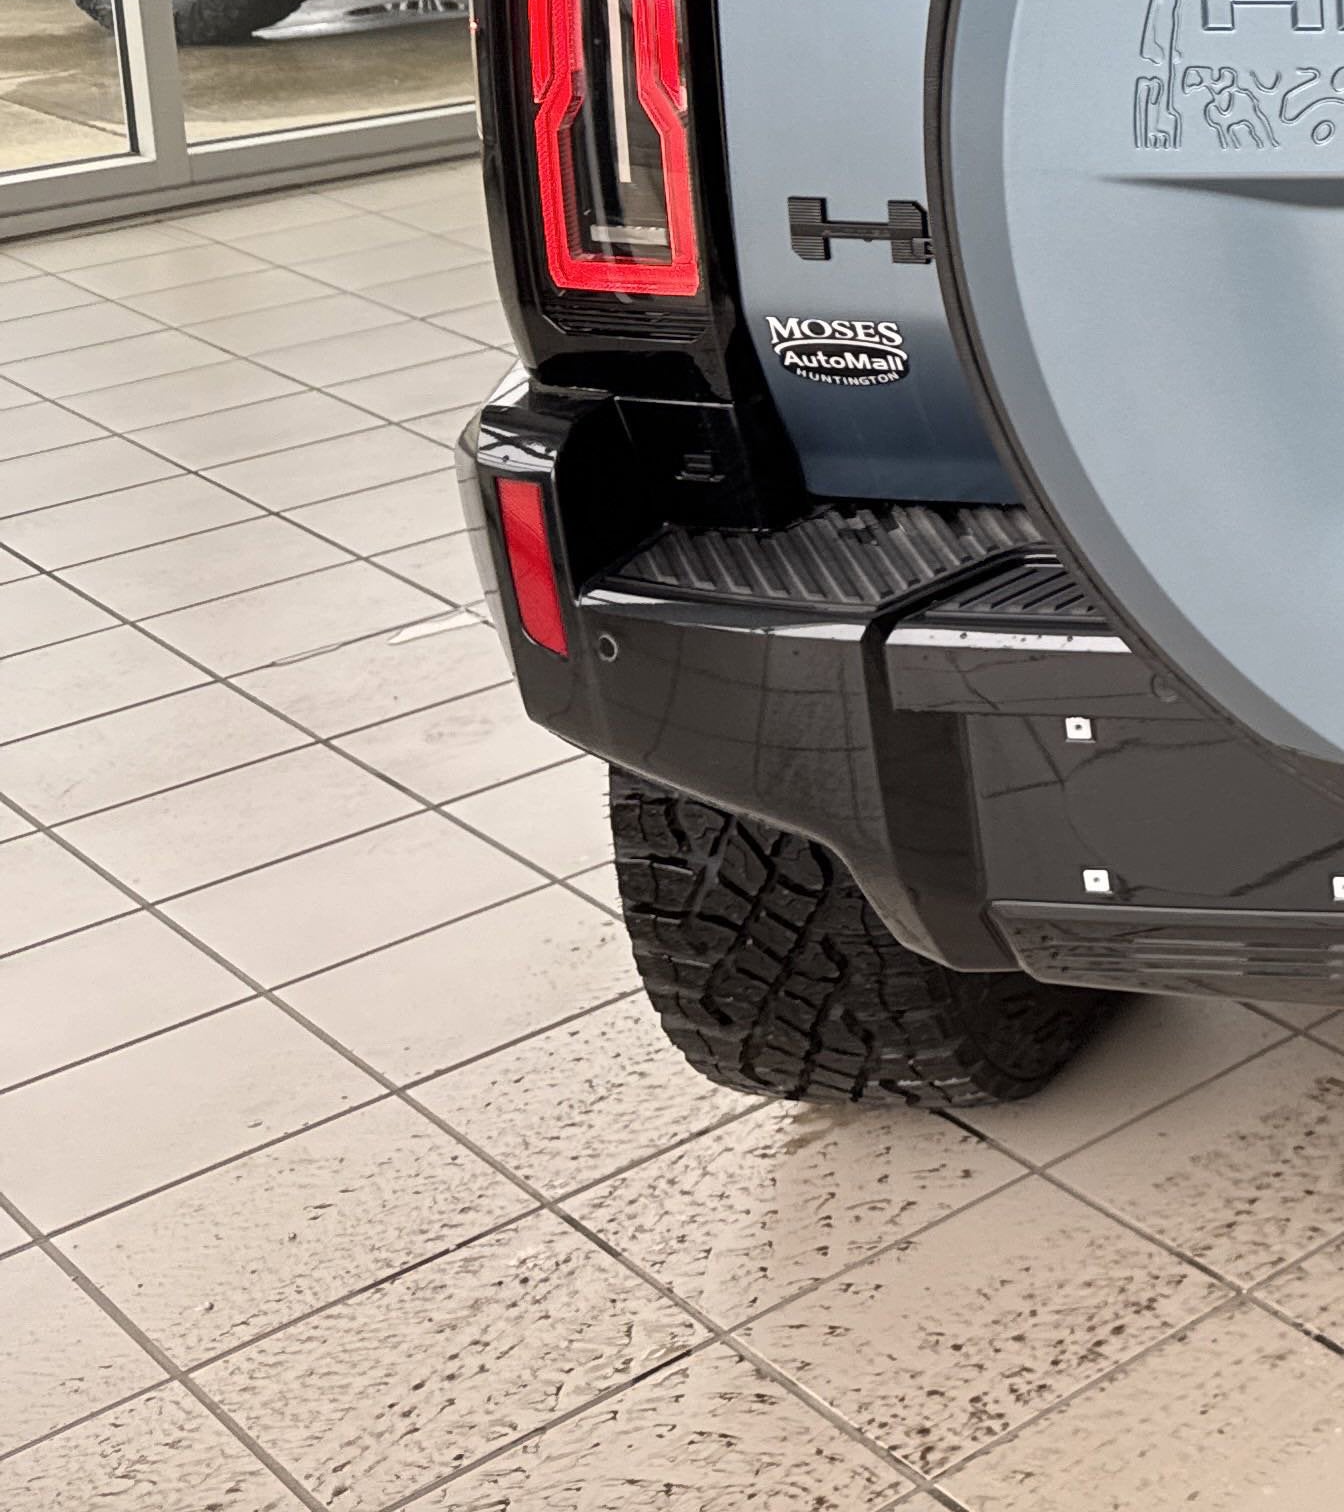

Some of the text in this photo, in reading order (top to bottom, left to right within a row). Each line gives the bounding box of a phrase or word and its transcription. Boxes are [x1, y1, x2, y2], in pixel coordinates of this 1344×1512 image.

[766, 316, 903, 346] MOSES
[784, 350, 904, 371] AutoMall
[796, 367, 899, 386] HUNTINGTON
